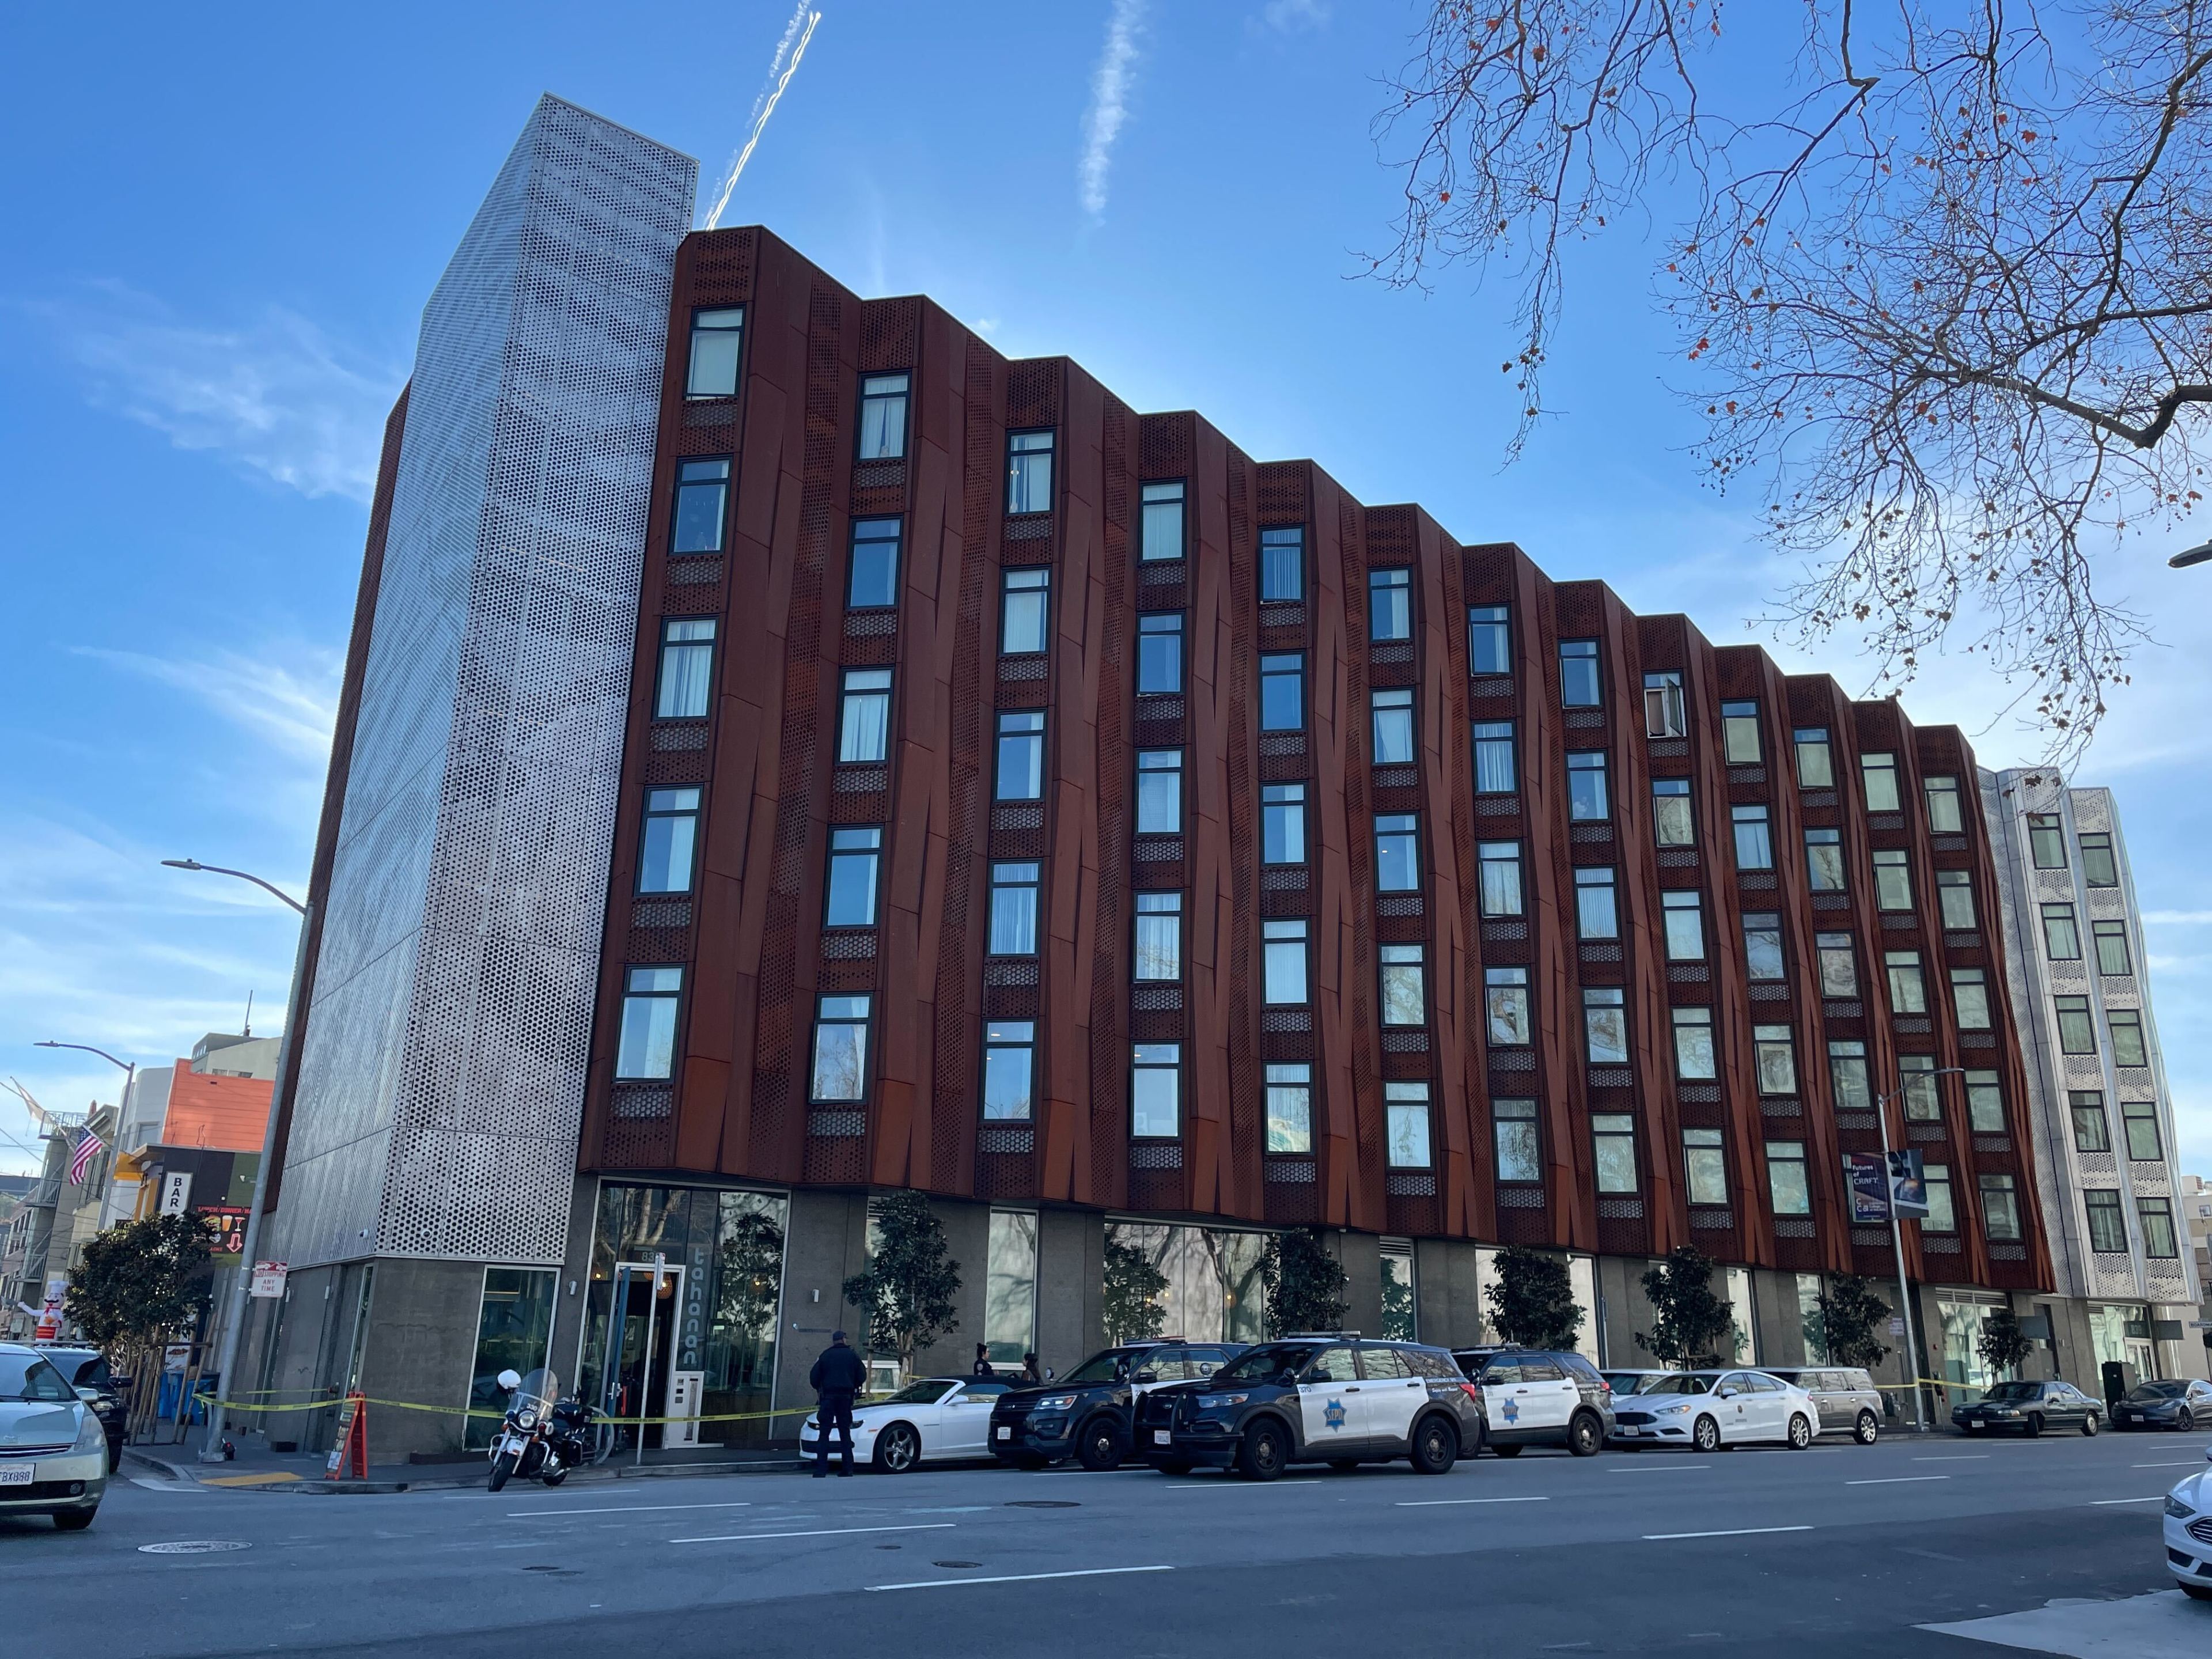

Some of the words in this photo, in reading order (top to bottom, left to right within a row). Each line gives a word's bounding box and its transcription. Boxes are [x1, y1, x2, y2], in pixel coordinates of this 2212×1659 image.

[1854, 1177, 1878, 1185] CRAFT
[170, 1177, 182, 1207] BAR
[255, 1269, 263, 1277] NO
[683, 1247, 704, 1365] tahanan
[527, 1403, 537, 1411] 330
